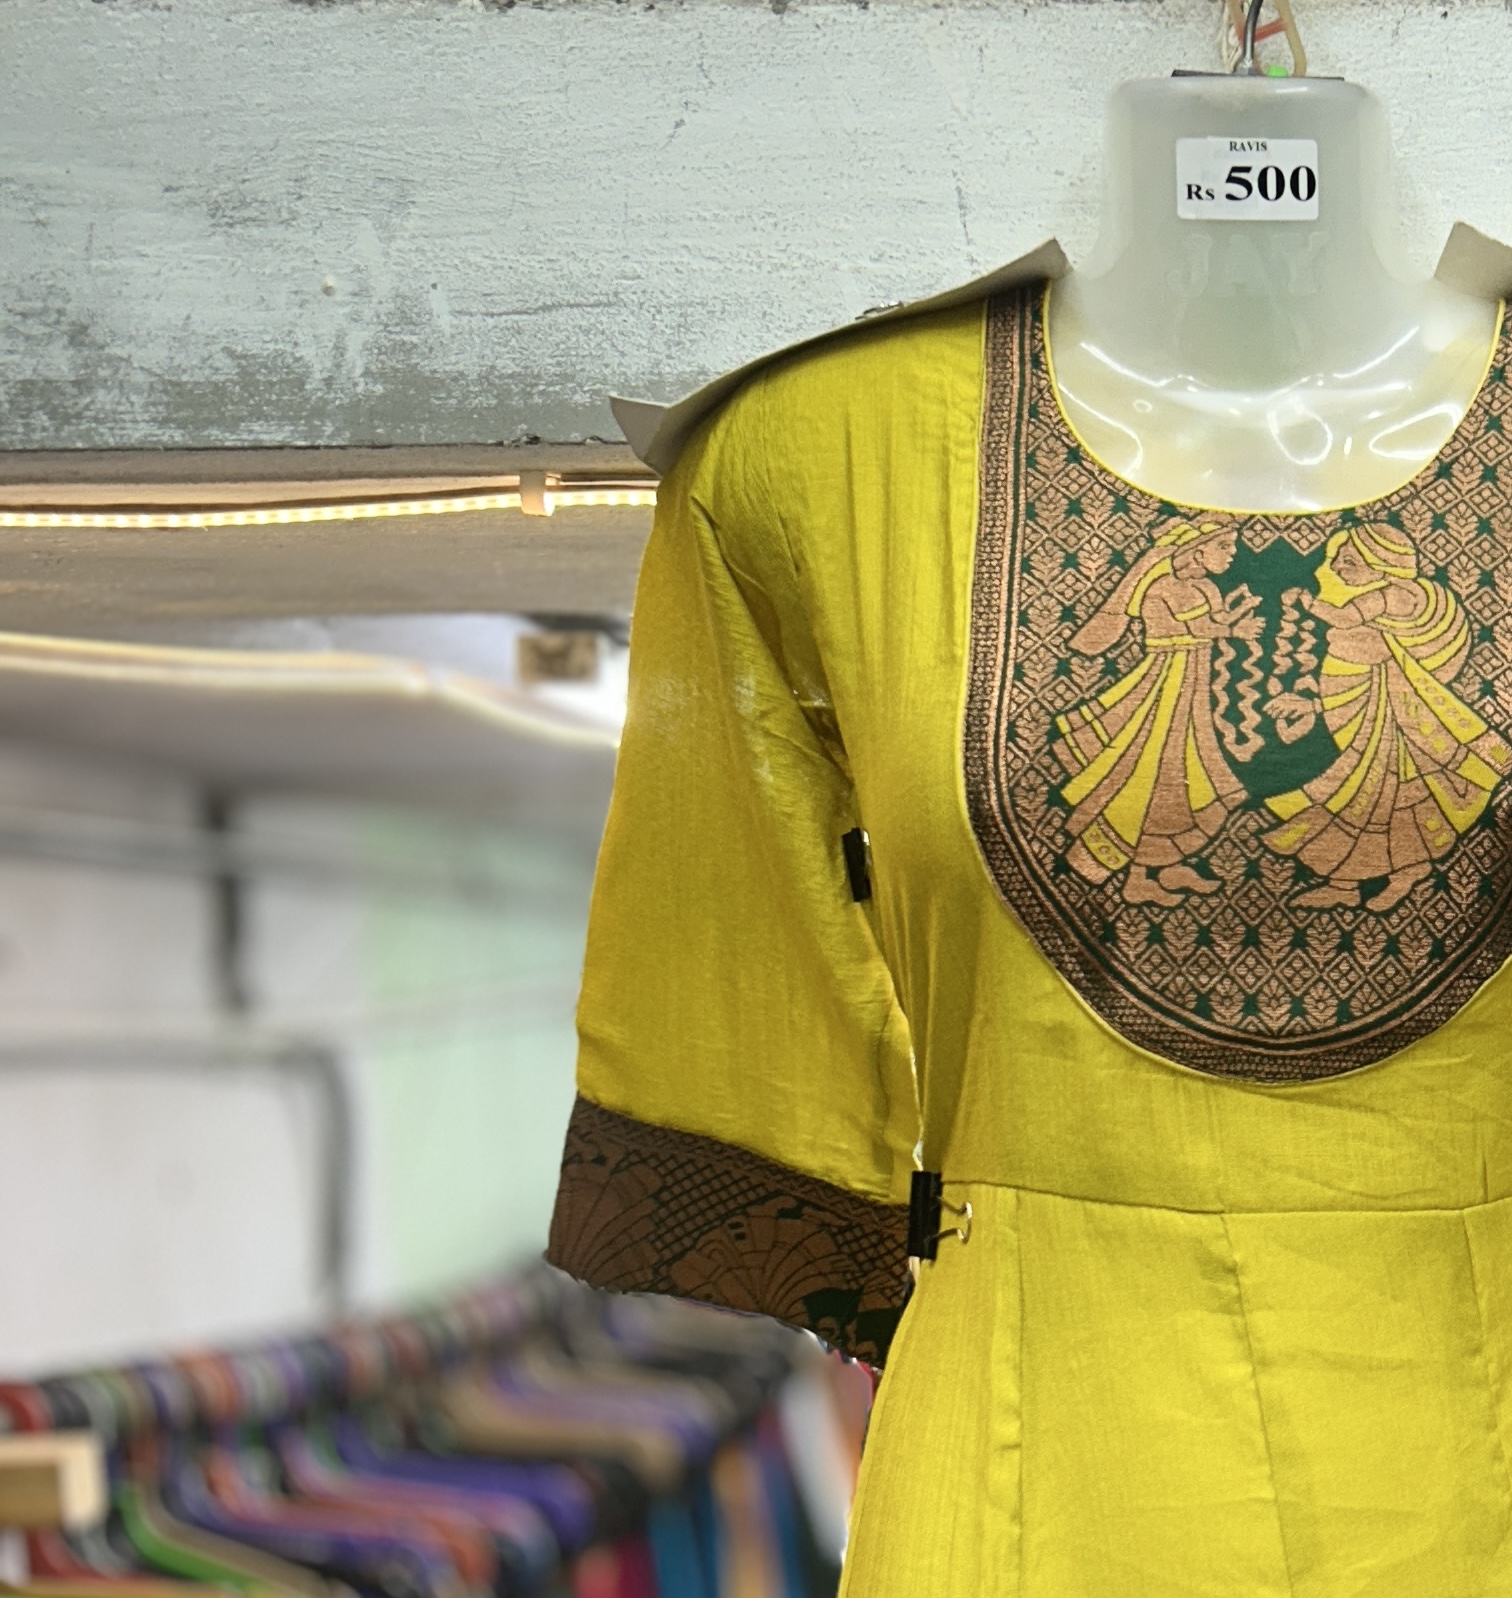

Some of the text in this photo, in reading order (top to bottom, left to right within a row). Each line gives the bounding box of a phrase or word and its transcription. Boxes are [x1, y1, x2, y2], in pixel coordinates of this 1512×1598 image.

[1229, 141, 1268, 152] RAVIS
[1186, 165, 1317, 202] Rs 500
